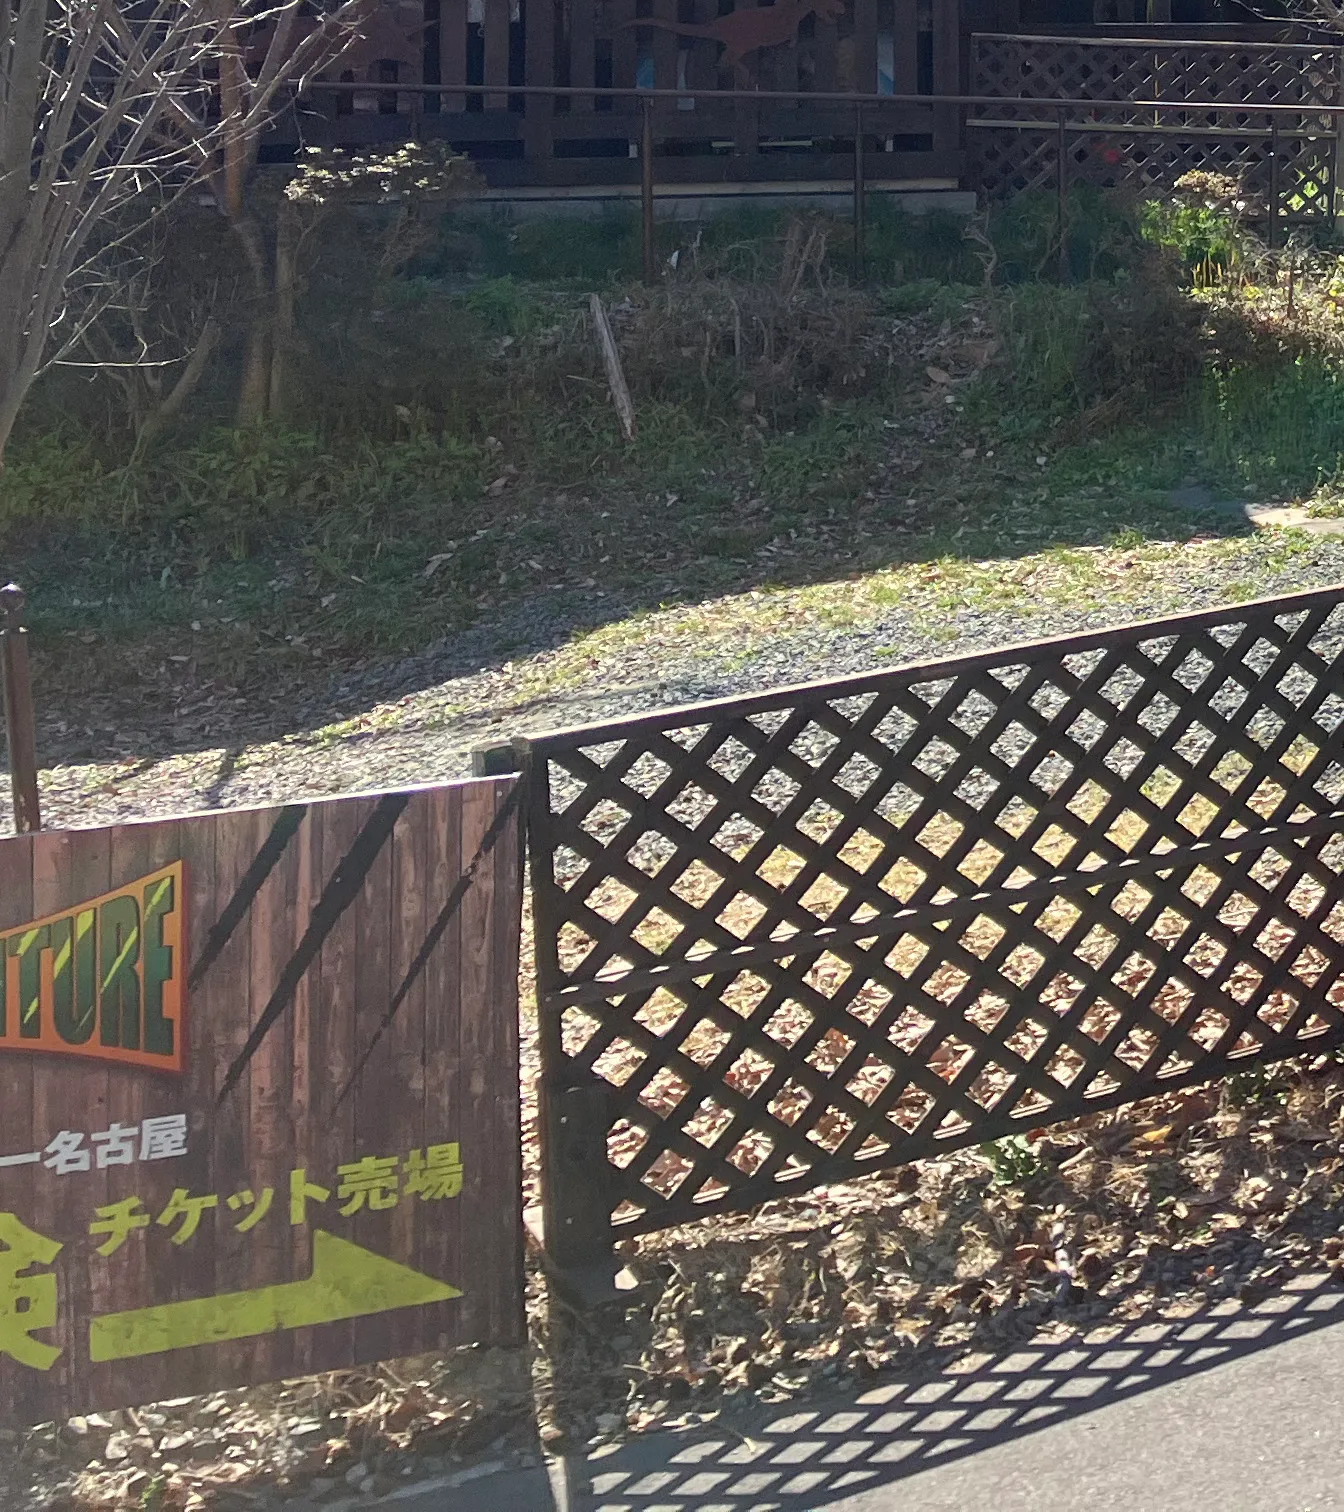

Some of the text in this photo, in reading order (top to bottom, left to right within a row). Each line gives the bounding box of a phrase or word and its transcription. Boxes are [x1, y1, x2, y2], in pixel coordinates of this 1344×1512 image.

[0, 874, 175, 1056] TURE
[89, 1141, 464, 1257] チケット売場
